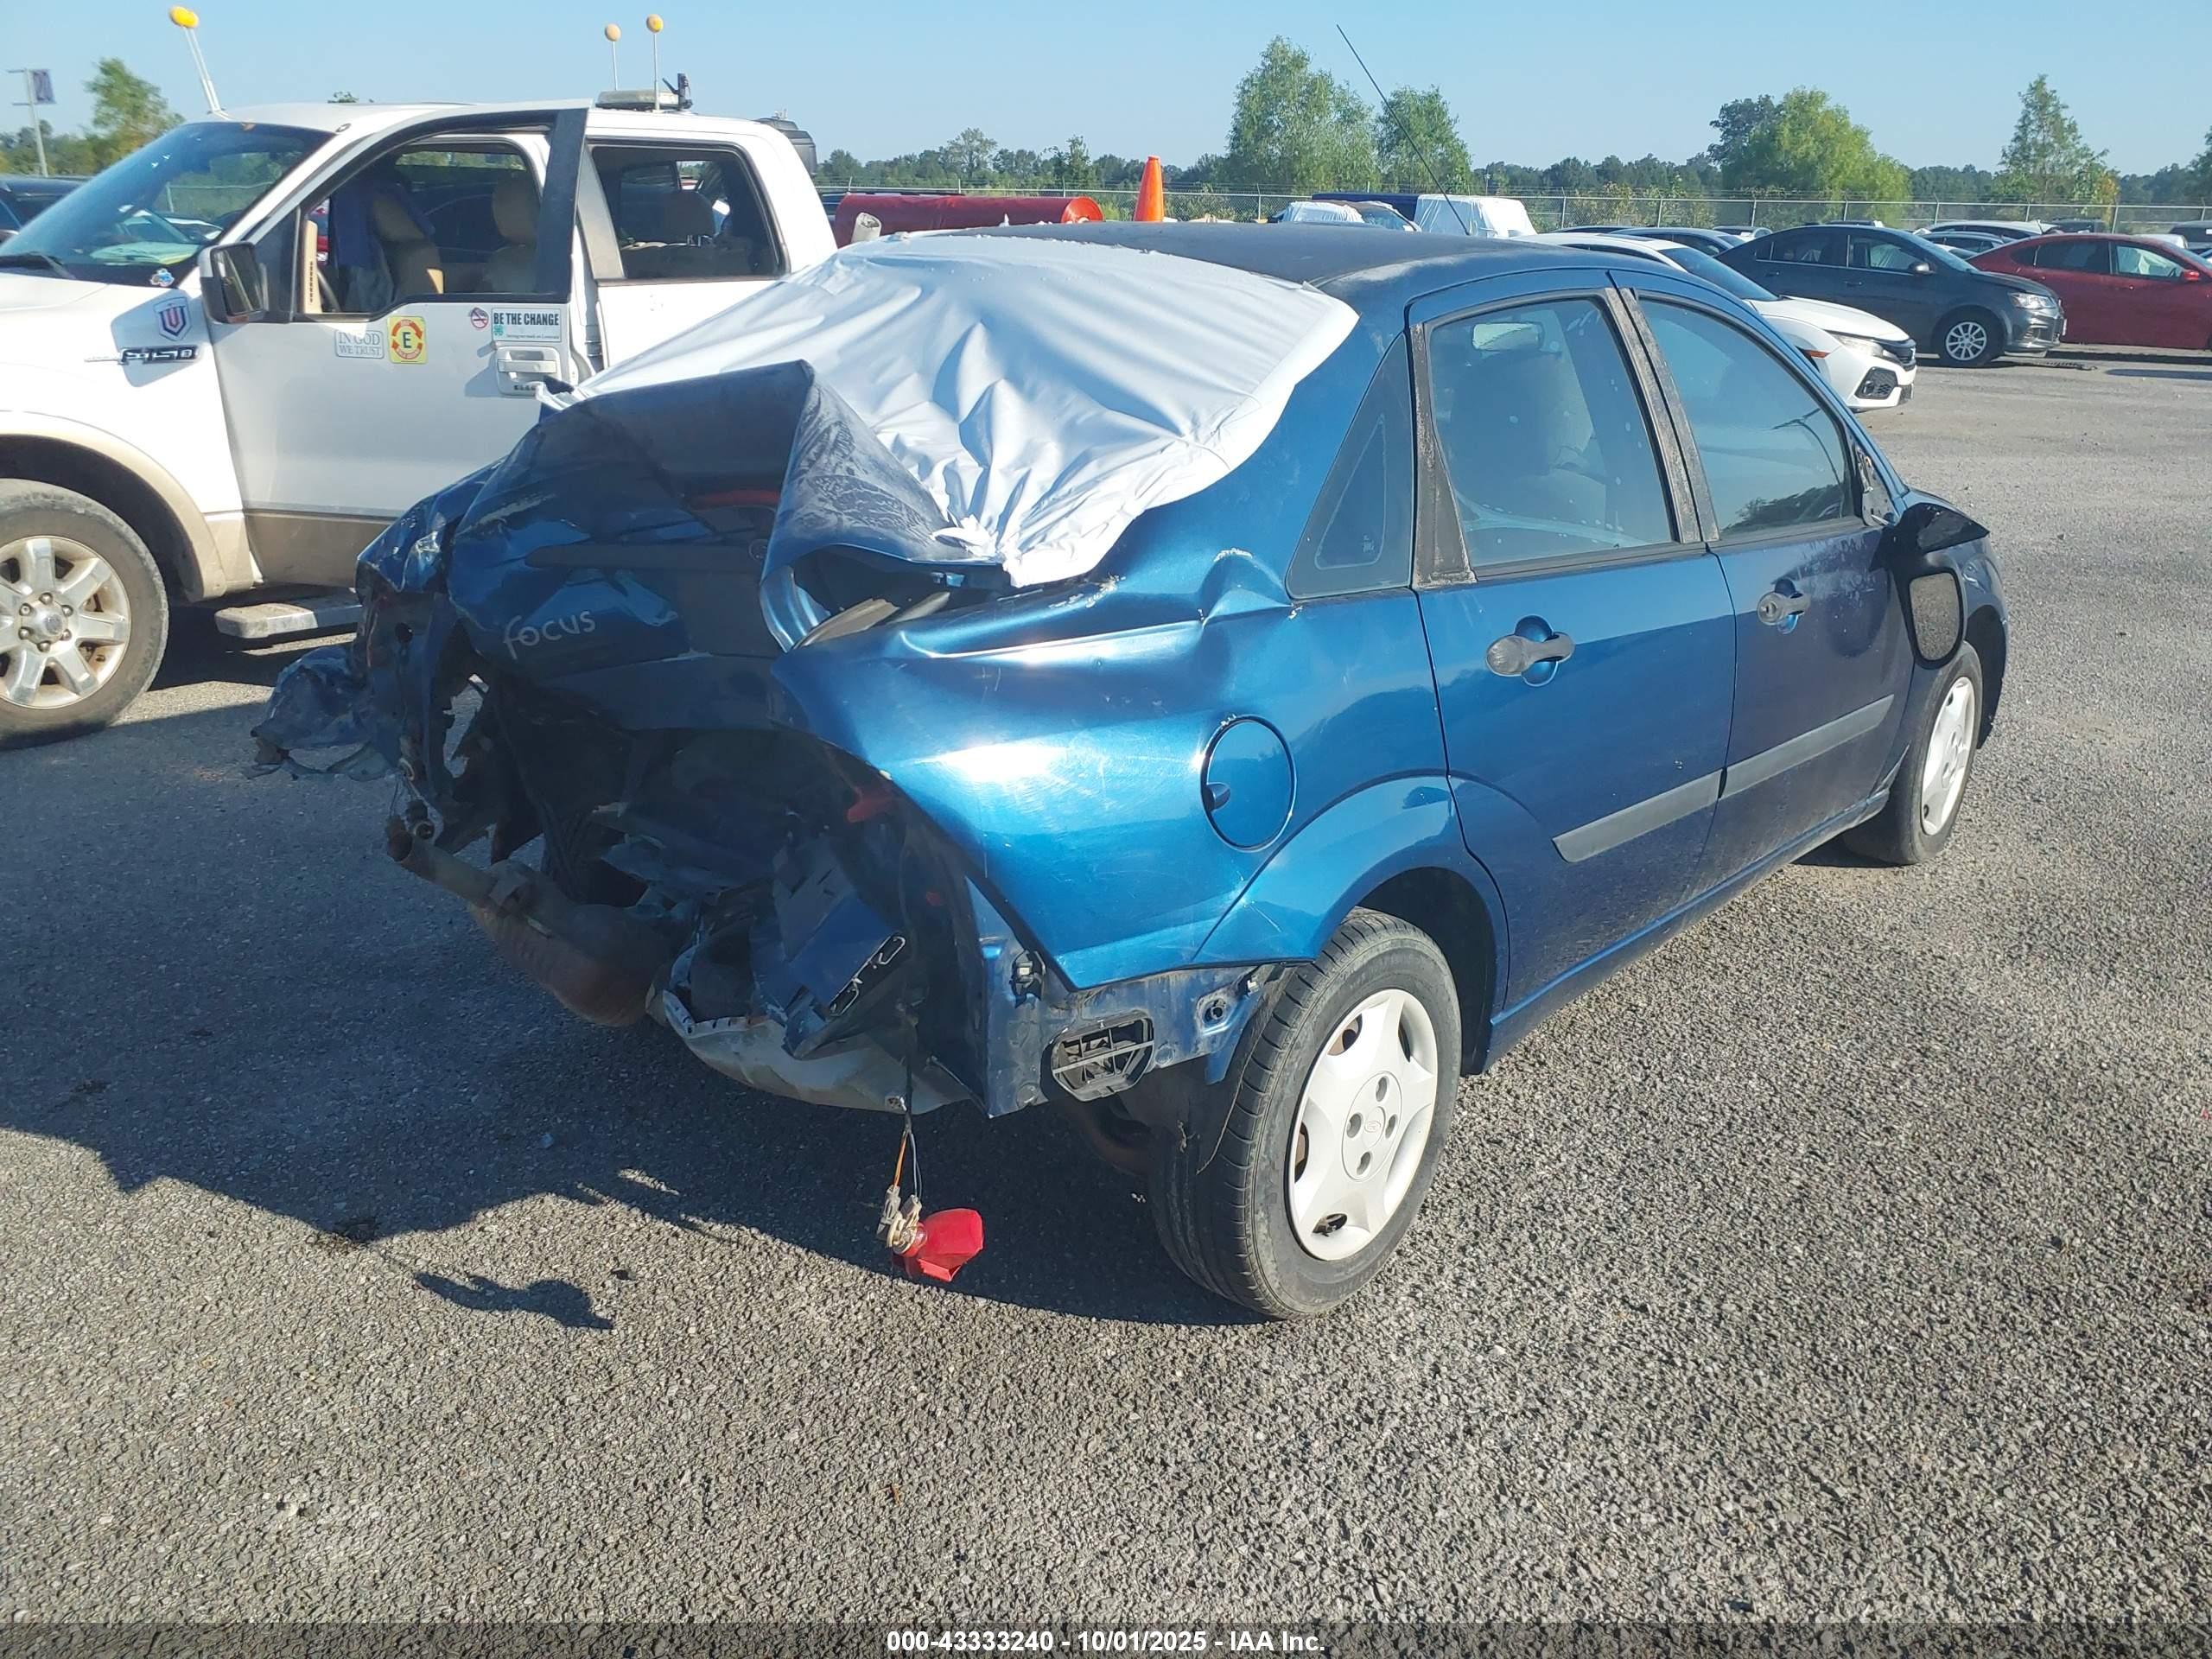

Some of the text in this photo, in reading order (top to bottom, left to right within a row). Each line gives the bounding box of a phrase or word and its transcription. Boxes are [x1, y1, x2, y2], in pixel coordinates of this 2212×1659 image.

[493, 312, 559, 326] BE THE CHANGE
[353, 333, 380, 346] GOD
[402, 331, 412, 349] E
[339, 345, 381, 356] WE TRUST
